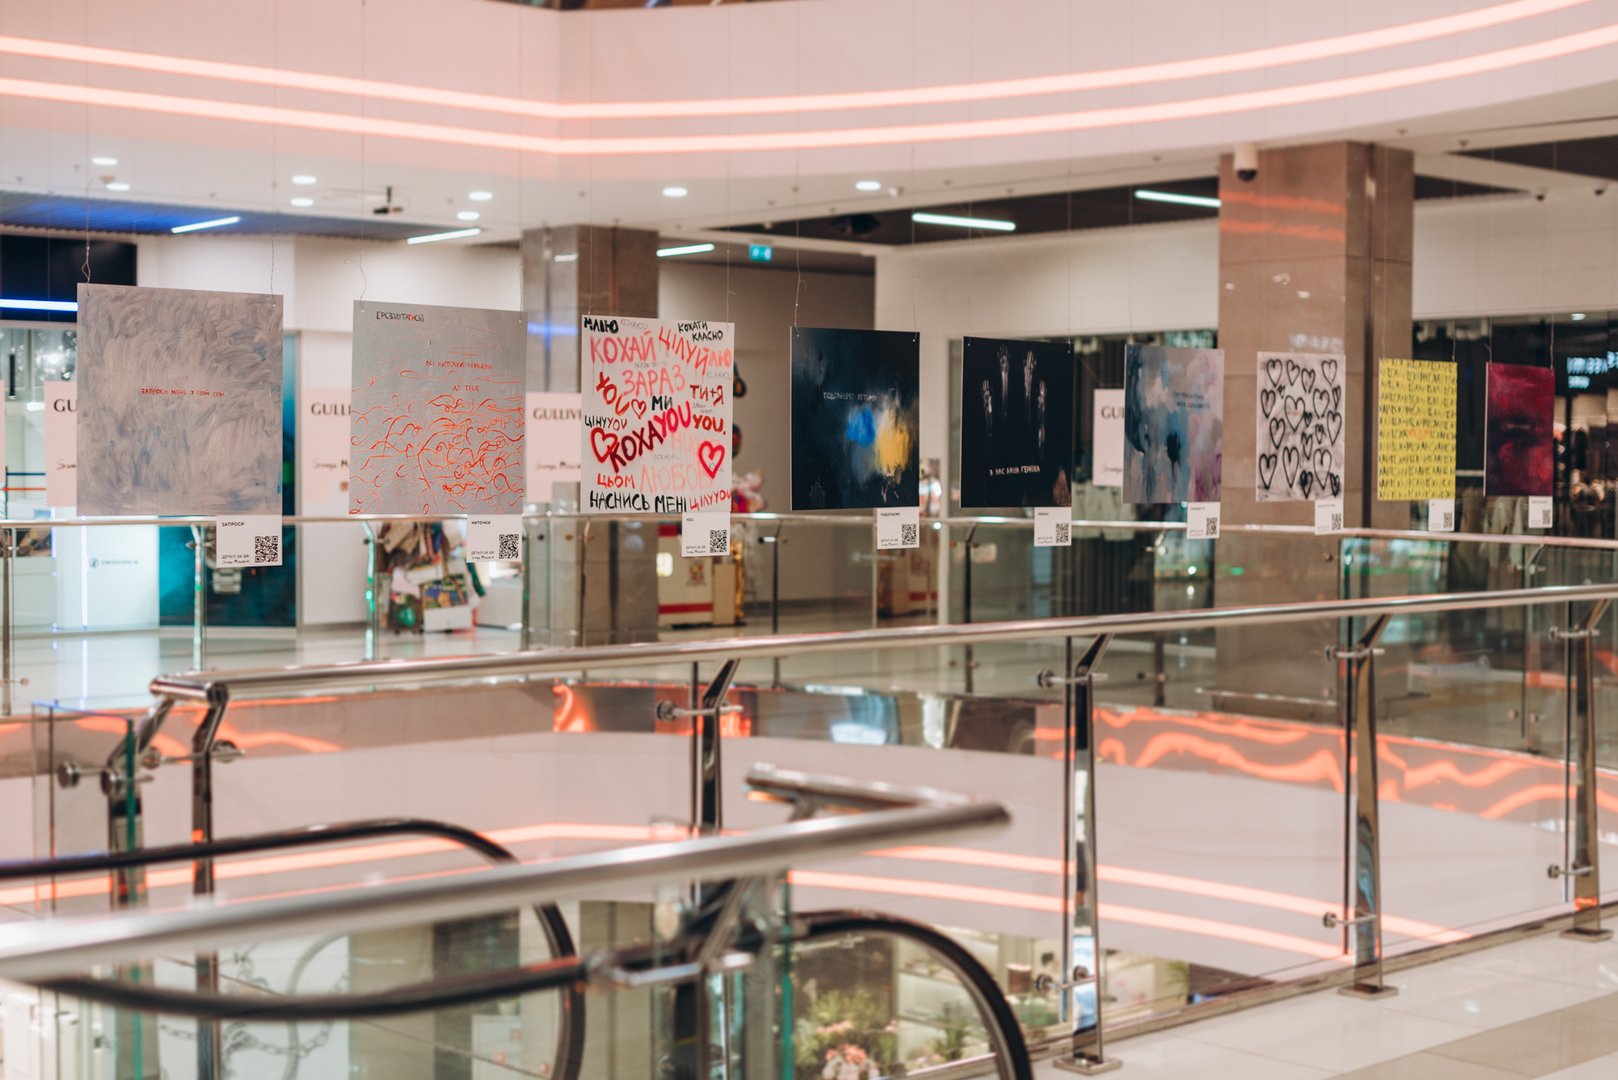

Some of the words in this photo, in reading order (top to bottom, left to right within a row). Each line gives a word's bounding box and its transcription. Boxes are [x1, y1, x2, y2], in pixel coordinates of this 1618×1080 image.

[589, 331, 657, 363] КОХАЙ
[622, 364, 686, 397] ЗАРАЗ
[651, 395, 673, 411] МИ
